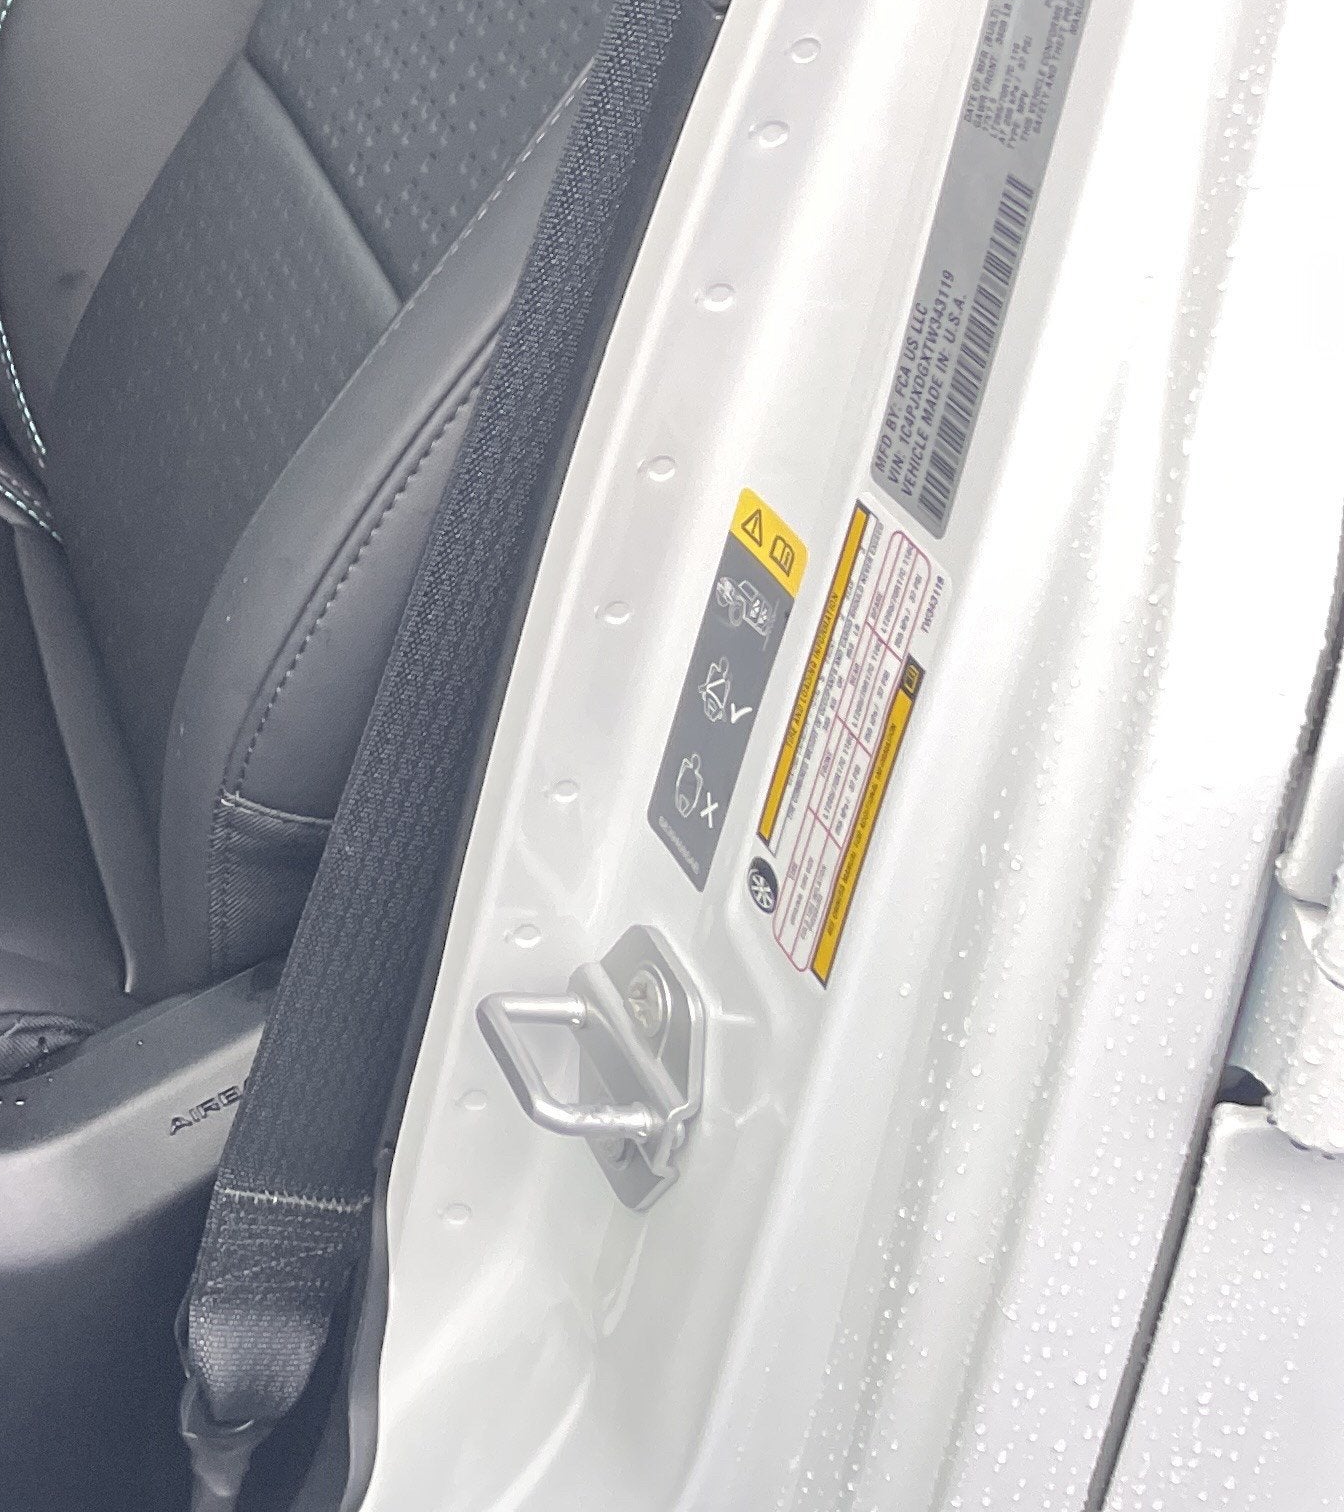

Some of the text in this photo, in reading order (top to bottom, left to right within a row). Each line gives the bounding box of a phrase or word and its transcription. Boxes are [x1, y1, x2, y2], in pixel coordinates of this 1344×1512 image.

[909, 300, 927, 335] LLC
[902, 334, 918, 362] US
[892, 362, 911, 399] FCA
[873, 432, 892, 473] MFD
[901, 425, 928, 498] VEHICLE
[920, 373, 944, 428] MADE
[169, 1079, 249, 1136] AIRB
